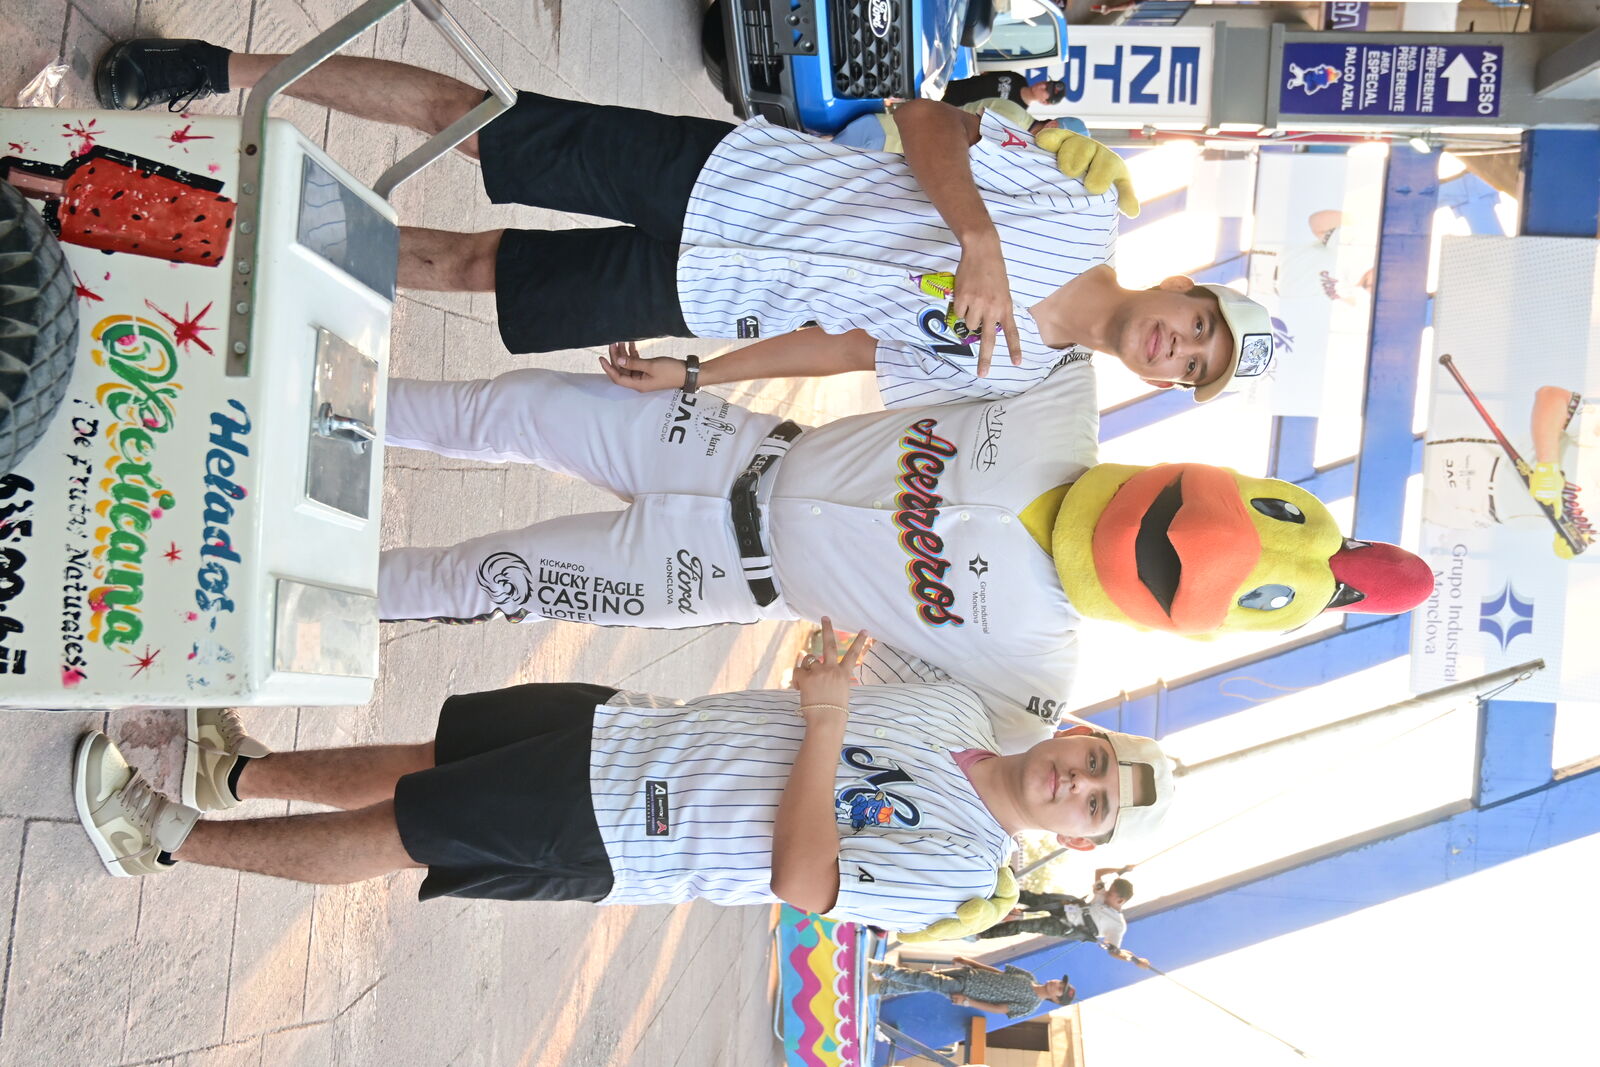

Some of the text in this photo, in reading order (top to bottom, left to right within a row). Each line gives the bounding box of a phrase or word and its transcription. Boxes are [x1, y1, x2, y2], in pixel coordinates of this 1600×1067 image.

[872, 0, 888, 29] Ford
[1341, 47, 1357, 111] PALCO AZUL
[1364, 50, 1381, 108] ESPECIAL
[1380, 51, 1392, 75] ÁREA
[1393, 46, 1410, 112] PREFERENTE
[1407, 46, 1418, 71] PALCO
[1421, 46, 1438, 113] PREFERENTE
[1477, 51, 1498, 114] ACCESO
[660, 389, 680, 443] START NOW
[668, 393, 697, 444] JAC
[982, 405, 1007, 467] MRCI
[705, 433, 722, 457] María
[1446, 459, 1457, 488] JAC
[539, 558, 585, 573] KICKAPOO
[539, 567, 645, 597] LUCKY EAGLE
[665, 557, 674, 604] MONCLOVA
[676, 549, 704, 615] Ford
[537, 585, 645, 616] CASINO
[541, 607, 597, 622] HOTEL
[979, 581, 991, 635] Grupo Industrial
[1425, 571, 1444, 655] Monclova
[1444, 544, 1468, 682] Grupo Industrial
